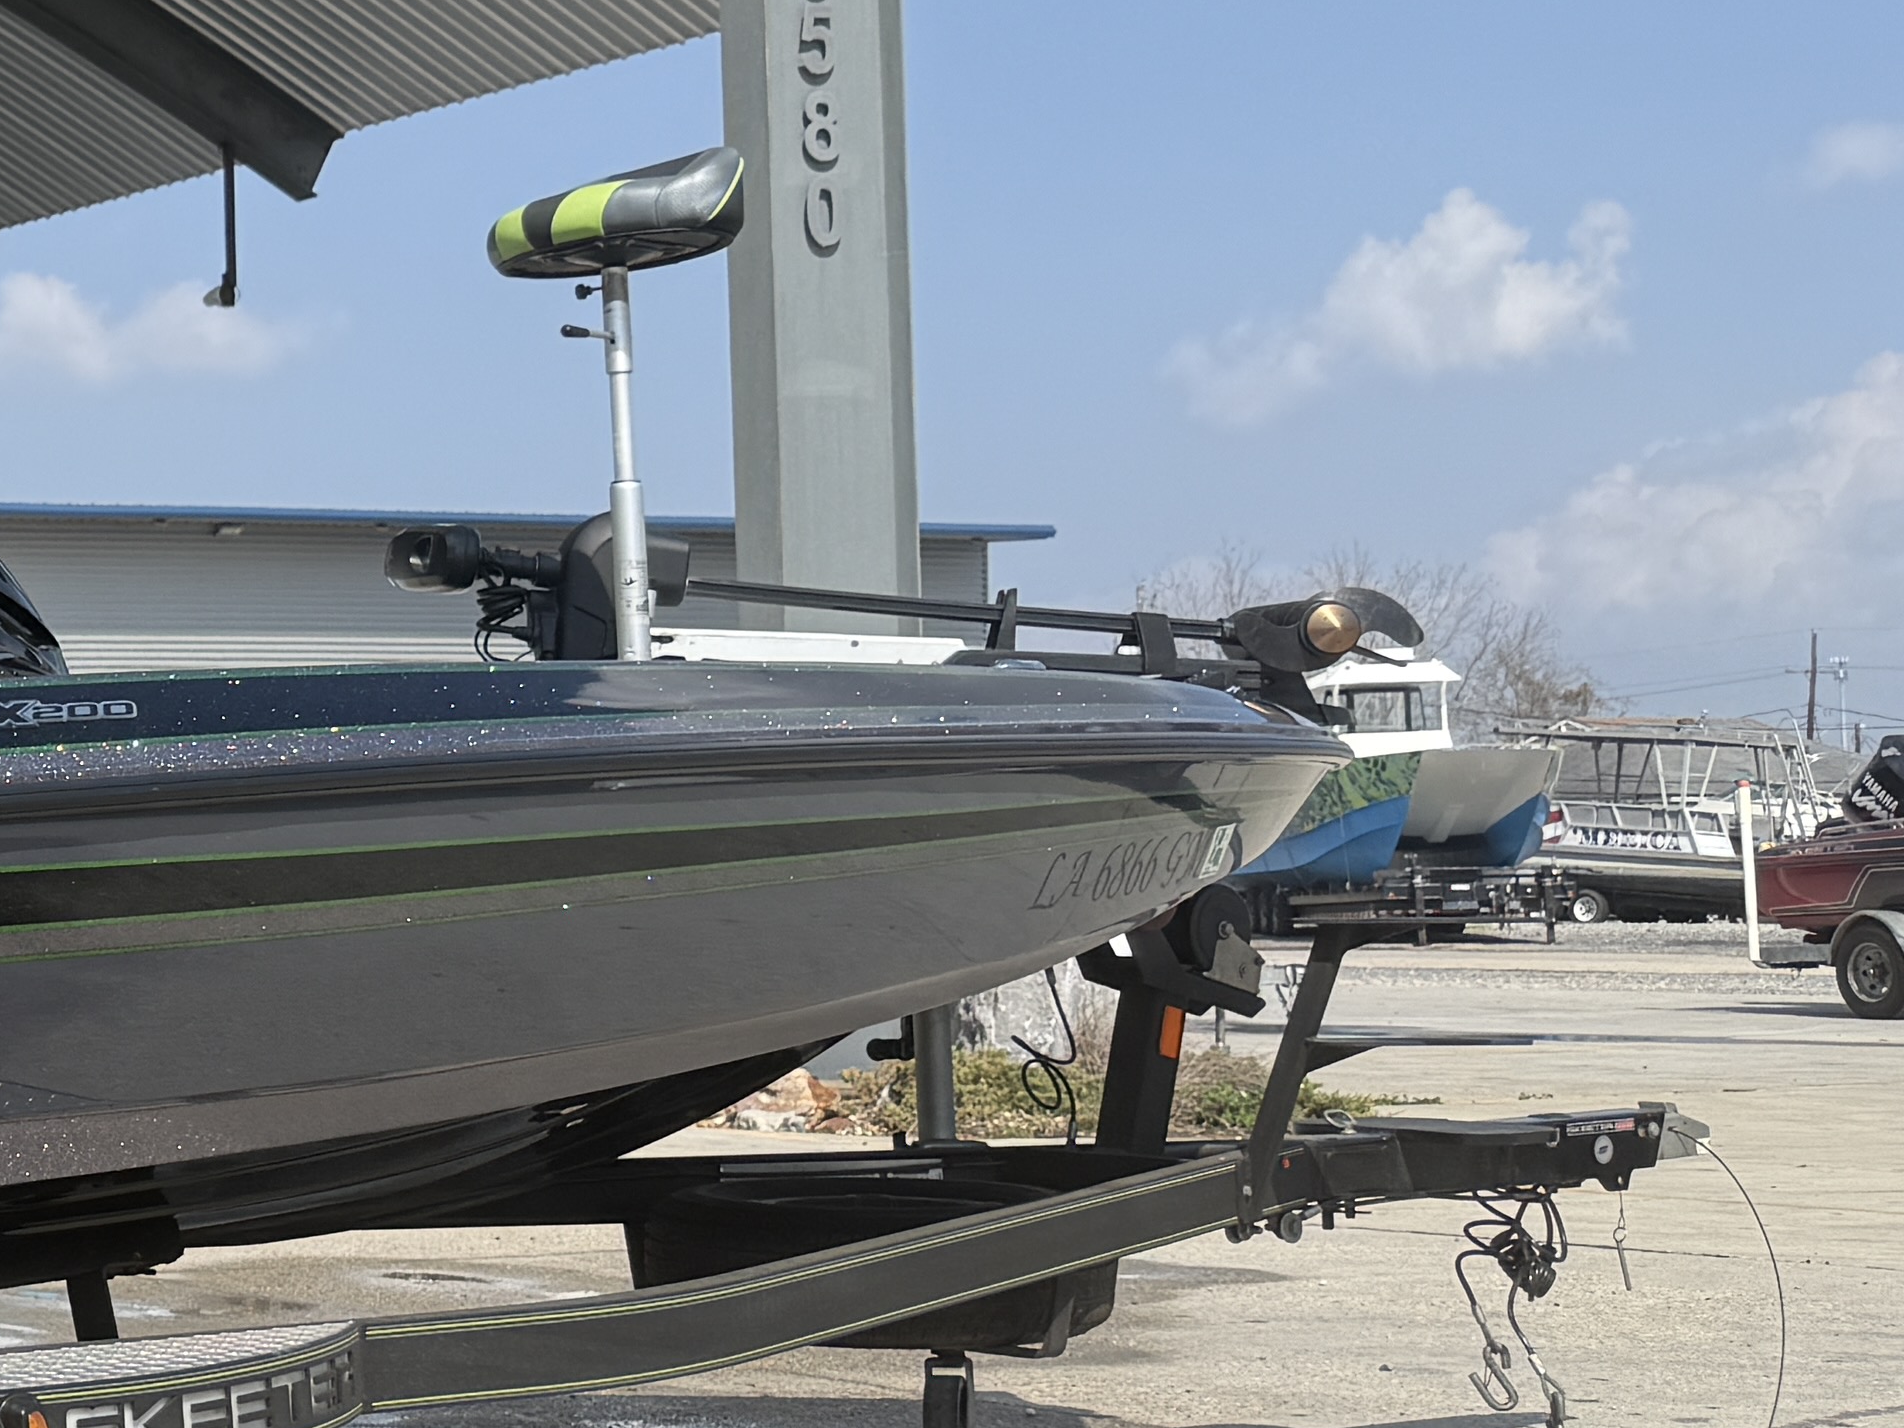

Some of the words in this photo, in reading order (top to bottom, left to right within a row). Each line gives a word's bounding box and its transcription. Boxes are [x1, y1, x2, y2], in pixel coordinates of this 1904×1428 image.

[1861, 771, 1899, 813] YAMAHA
[1027, 849, 1092, 910] LA
[1092, 835, 1168, 902] 6866
